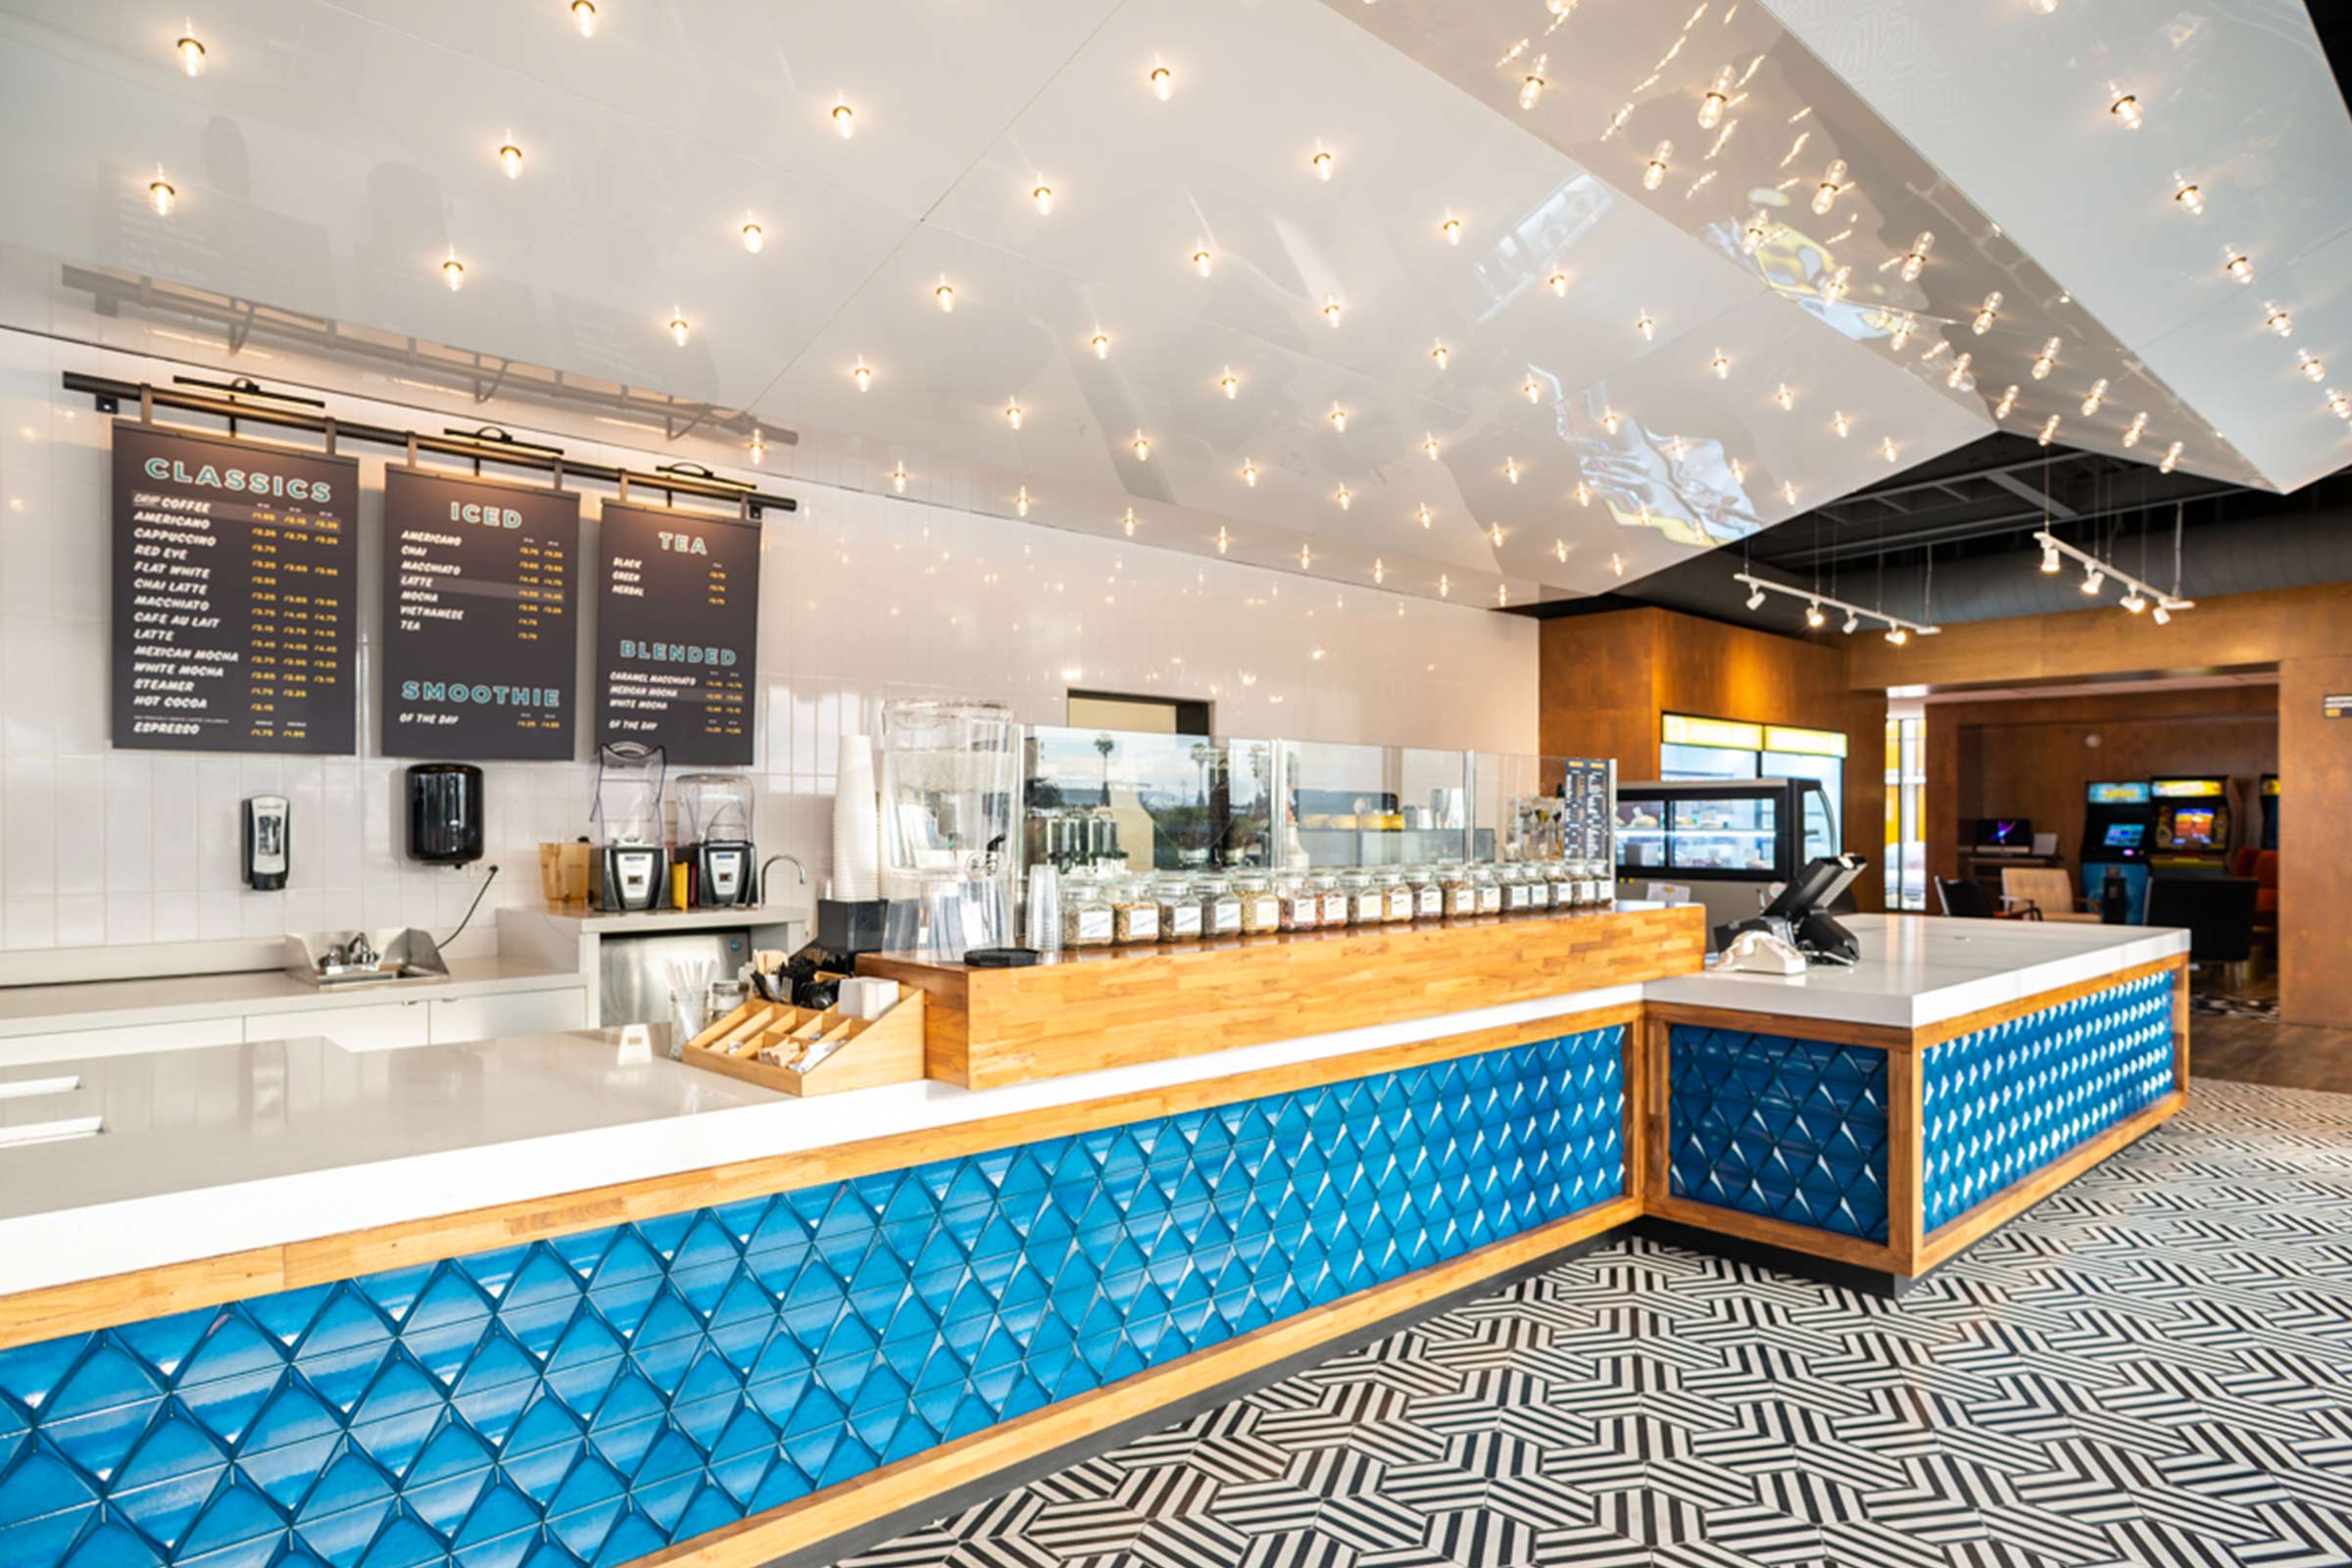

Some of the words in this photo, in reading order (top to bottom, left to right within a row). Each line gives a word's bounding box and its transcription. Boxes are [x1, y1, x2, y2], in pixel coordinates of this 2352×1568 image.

[145, 458, 331, 503] CLASSICS
[161, 494, 212, 514] COFFEE
[133, 512, 212, 530] AMERICANO
[450, 501, 522, 529] ICED
[133, 527, 218, 547] CAPPUCCINO
[401, 529, 463, 547] AMERICANO
[658, 530, 708, 556] TEA
[133, 545, 161, 557] RED
[163, 547, 188, 561] EYE
[401, 545, 427, 557] CHAI
[133, 561, 165, 574] FLAT
[169, 564, 211, 579] WHITE
[401, 561, 462, 575] MACCHIATO
[612, 557, 643, 569] BLACK
[401, 575, 433, 588] LATTE
[612, 570, 641, 582] GREEN
[133, 577, 166, 590] CHAI
[168, 580, 208, 595] LATTE
[612, 585, 644, 597] HERBAL
[133, 595, 210, 612] MACCHIATO
[401, 590, 439, 603] MOCHA
[133, 612, 169, 625] CAFE
[170, 614, 189, 626] AU
[191, 616, 220, 628] LAIT
[400, 606, 464, 620] VIETNAMESE
[400, 620, 421, 631] TEA
[133, 628, 174, 642] LATTE
[133, 646, 191, 659] MEXICAN
[193, 650, 239, 662] MOCHA
[619, 639, 737, 666] BLENDED
[133, 662, 175, 674] WHITE
[178, 664, 223, 677] MOCHA
[133, 678, 194, 692] STEAMER
[610, 671, 649, 684] CARAMEL
[649, 674, 697, 686] MACCHIATO
[401, 680, 561, 708] SMOOTHIE
[610, 685, 647, 697] MEXICAN
[648, 687, 678, 698] MOCHA
[133, 695, 162, 707] HOT
[164, 697, 208, 710] COCOA
[609, 699, 636, 710] WHITE
[638, 700, 668, 710] MOCHA
[400, 712, 415, 723] OF
[417, 713, 437, 724] THE
[439, 714, 459, 725] DAY
[609, 719, 621, 729] OF
[622, 720, 640, 730] THE
[641, 720, 658, 731] DAY
[133, 722, 200, 734] ESPRESSO
